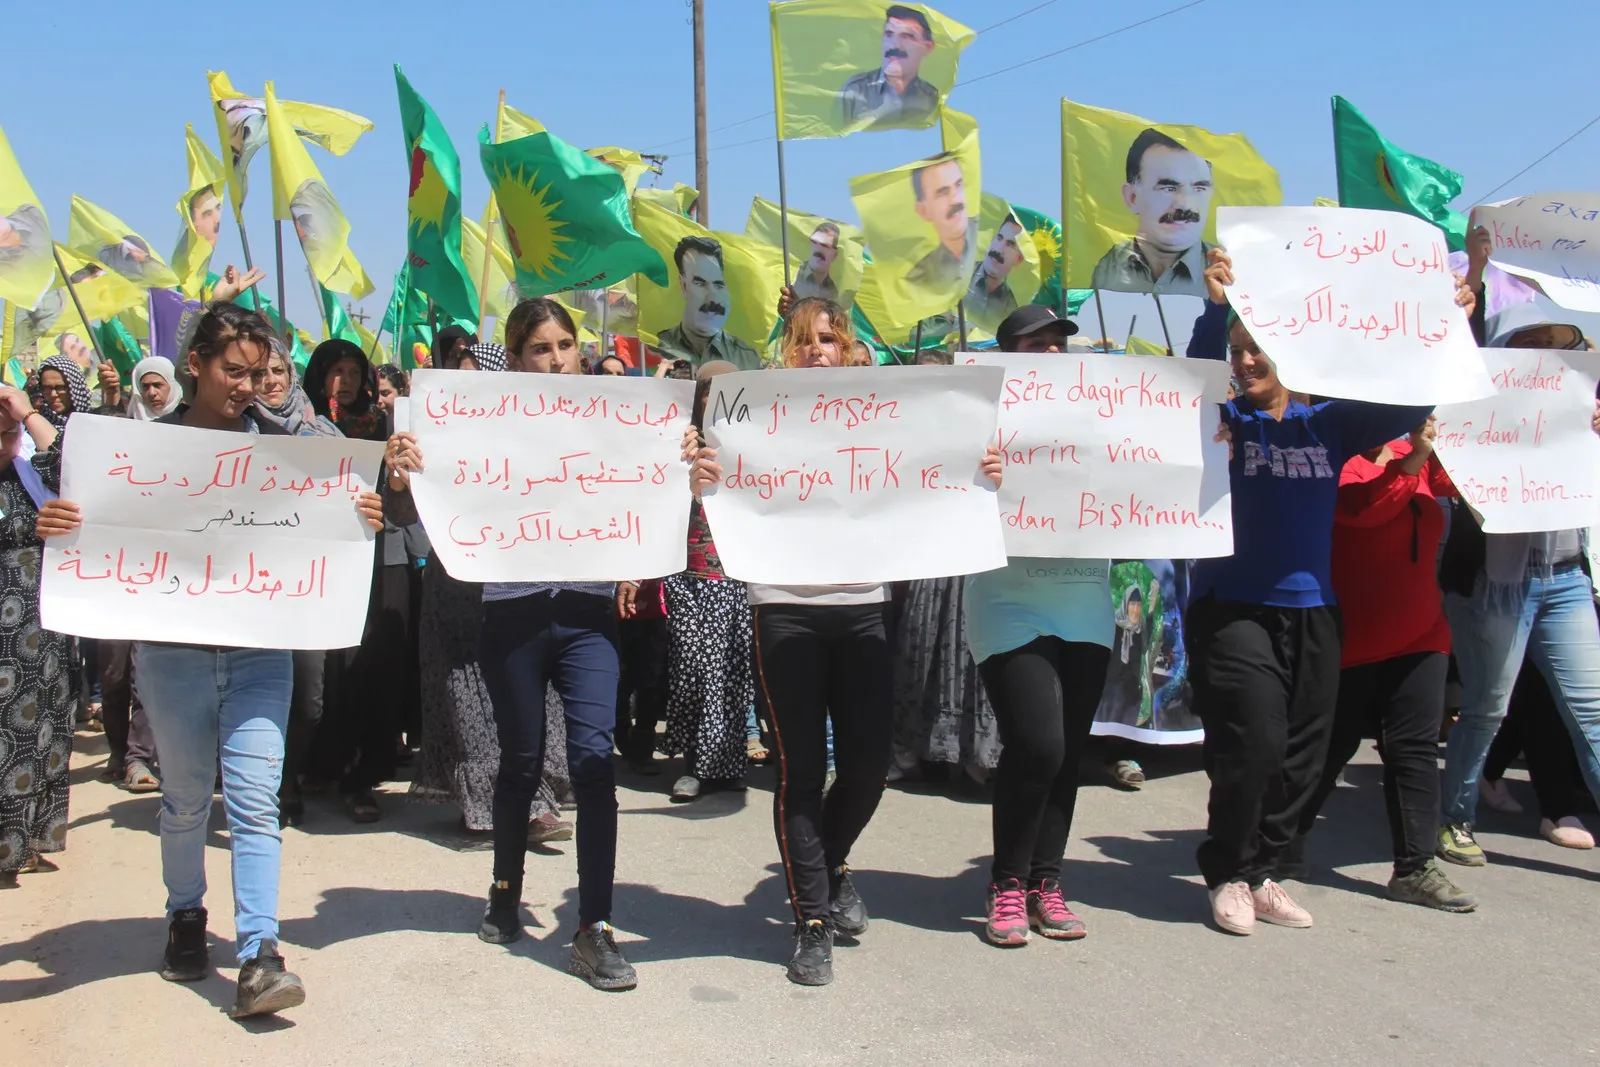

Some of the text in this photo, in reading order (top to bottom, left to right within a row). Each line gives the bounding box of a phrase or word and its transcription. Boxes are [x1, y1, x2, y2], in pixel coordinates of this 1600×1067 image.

[1391, 242, 1445, 274] الموت
[1239, 285, 1448, 348] تحيا الوحدة الكردية
[523, 392, 608, 419] الاحتلال
[1002, 370, 1056, 410] şên
[614, 401, 680, 436] هجمات
[712, 387, 752, 427] Na
[767, 393, 789, 436] ji
[1106, 437, 1163, 464] vîna
[107, 444, 361, 501] بالوحدة الكردية
[453, 457, 511, 491] إرادة
[520, 451, 592, 496] كسر
[651, 461, 670, 486] لا
[724, 453, 834, 502] dagiriya
[1001, 496, 1056, 533] dan
[448, 510, 642, 559] الشعب الكردي
[56, 547, 328, 601] الاحتلال والخيانة
[1026, 568, 1059, 578] LOS
